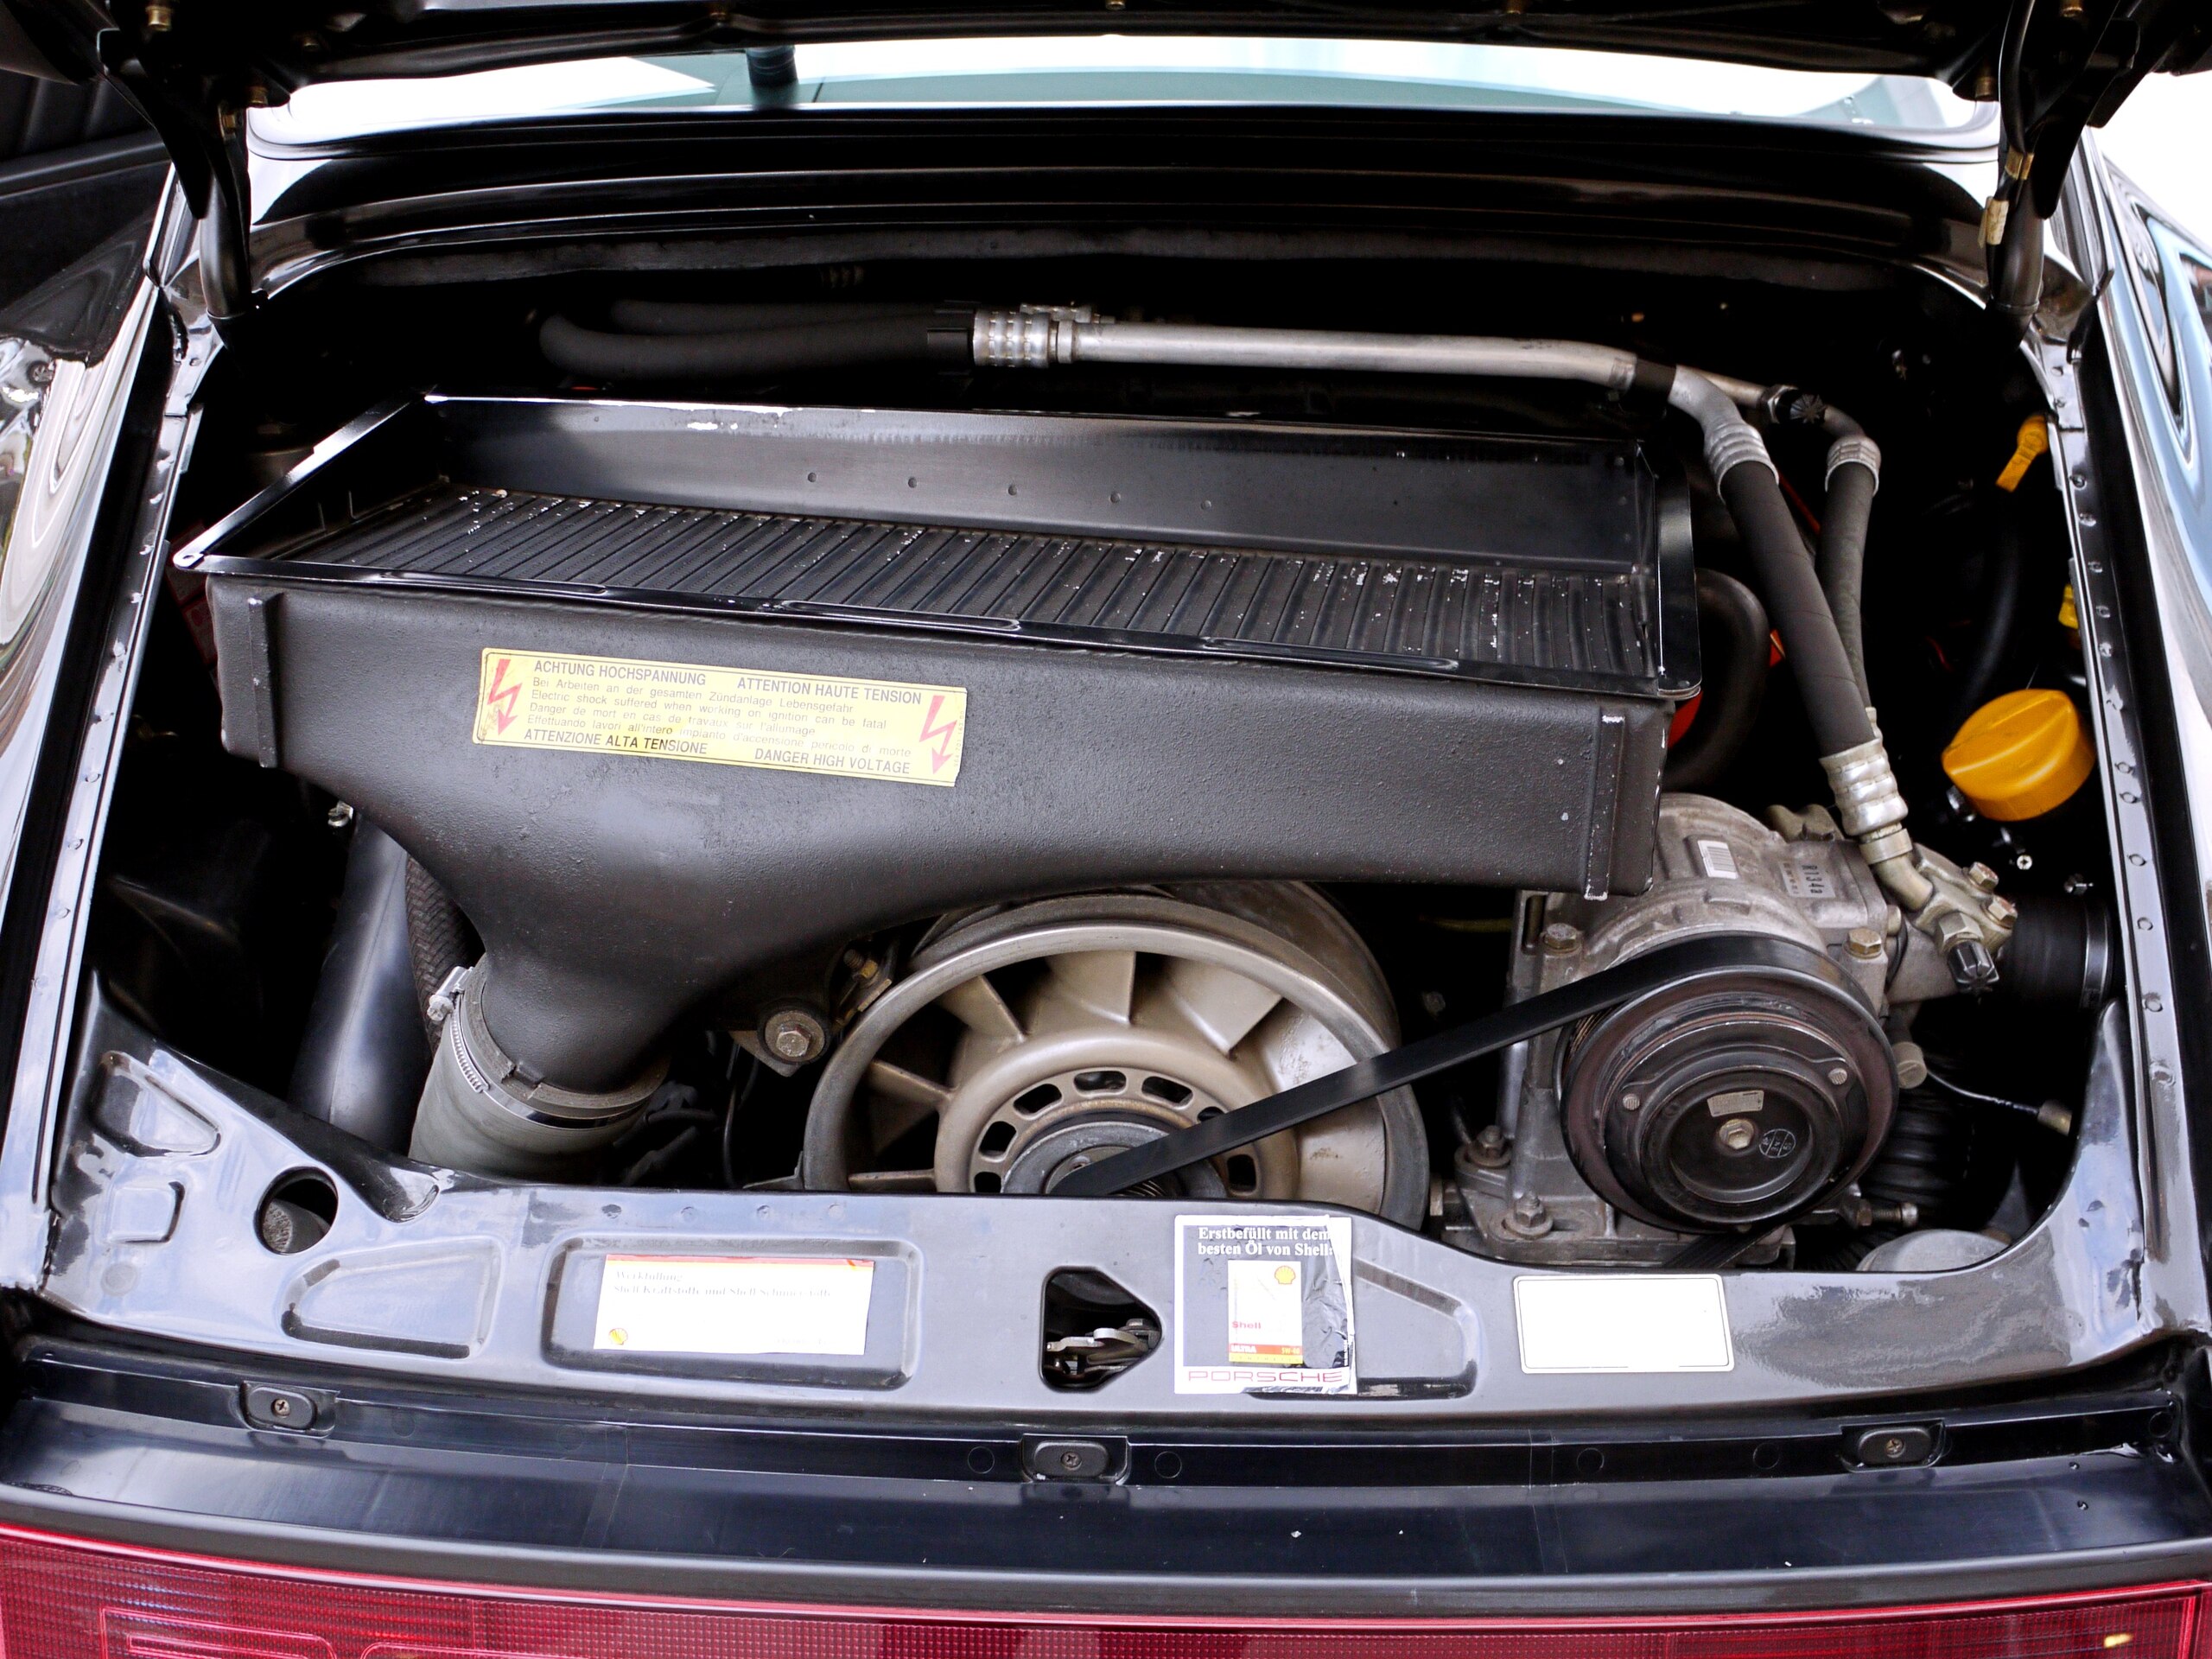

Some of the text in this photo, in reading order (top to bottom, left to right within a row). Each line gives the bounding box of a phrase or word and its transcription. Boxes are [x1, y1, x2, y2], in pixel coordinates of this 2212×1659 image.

[535, 660, 706, 685] ACHTUNG HOCHSPANNUNG
[533, 677, 549, 688] Bei
[556, 680, 599, 691] Arbeiten
[626, 686, 643, 696] der
[650, 688, 702, 700] gesamten
[709, 691, 772, 707] Zündanlage
[780, 699, 854, 713] Lebensgefahr
[737, 677, 921, 704] ATTENTION HAUTE TENSION
[530, 703, 566, 715] Danger
[574, 706, 586, 715] de
[593, 709, 616, 718] mort
[643, 713, 661, 721] cas
[668, 715, 682, 723] de
[689, 715, 728, 728] travaux
[736, 720, 753, 728] sur
[760, 721, 815, 736] l'allumage
[531, 690, 569, 701] Electric
[577, 694, 607, 704] shock
[614, 696, 657, 709] suffered
[664, 702, 691, 712] when
[699, 703, 741, 718] working
[769, 710, 808, 722] ignition
[842, 716, 855, 726] be
[862, 718, 886, 729] fatal
[524, 729, 708, 754] ATTENZIONE ALTA TENSIONE
[527, 715, 586, 728] Effettuando
[593, 719, 620, 729] lavori
[628, 722, 673, 734] all'intero
[679, 728, 726, 740] impianto
[734, 732, 804, 747] d'accensione
[811, 741, 855, 753] pericolo
[880, 747, 911, 758] morte
[755, 748, 910, 774] DANGER HIGH VOLTAGE
[1198, 1227, 1331, 1240] Erstbefüllt mit dem
[1198, 1243, 1241, 1255] besten
[1245, 1240, 1262, 1255] Öl
[1268, 1245, 1290, 1255] von
[1232, 1321, 1262, 1330] Shell
[1189, 1370, 1343, 1382] PORSCHE
